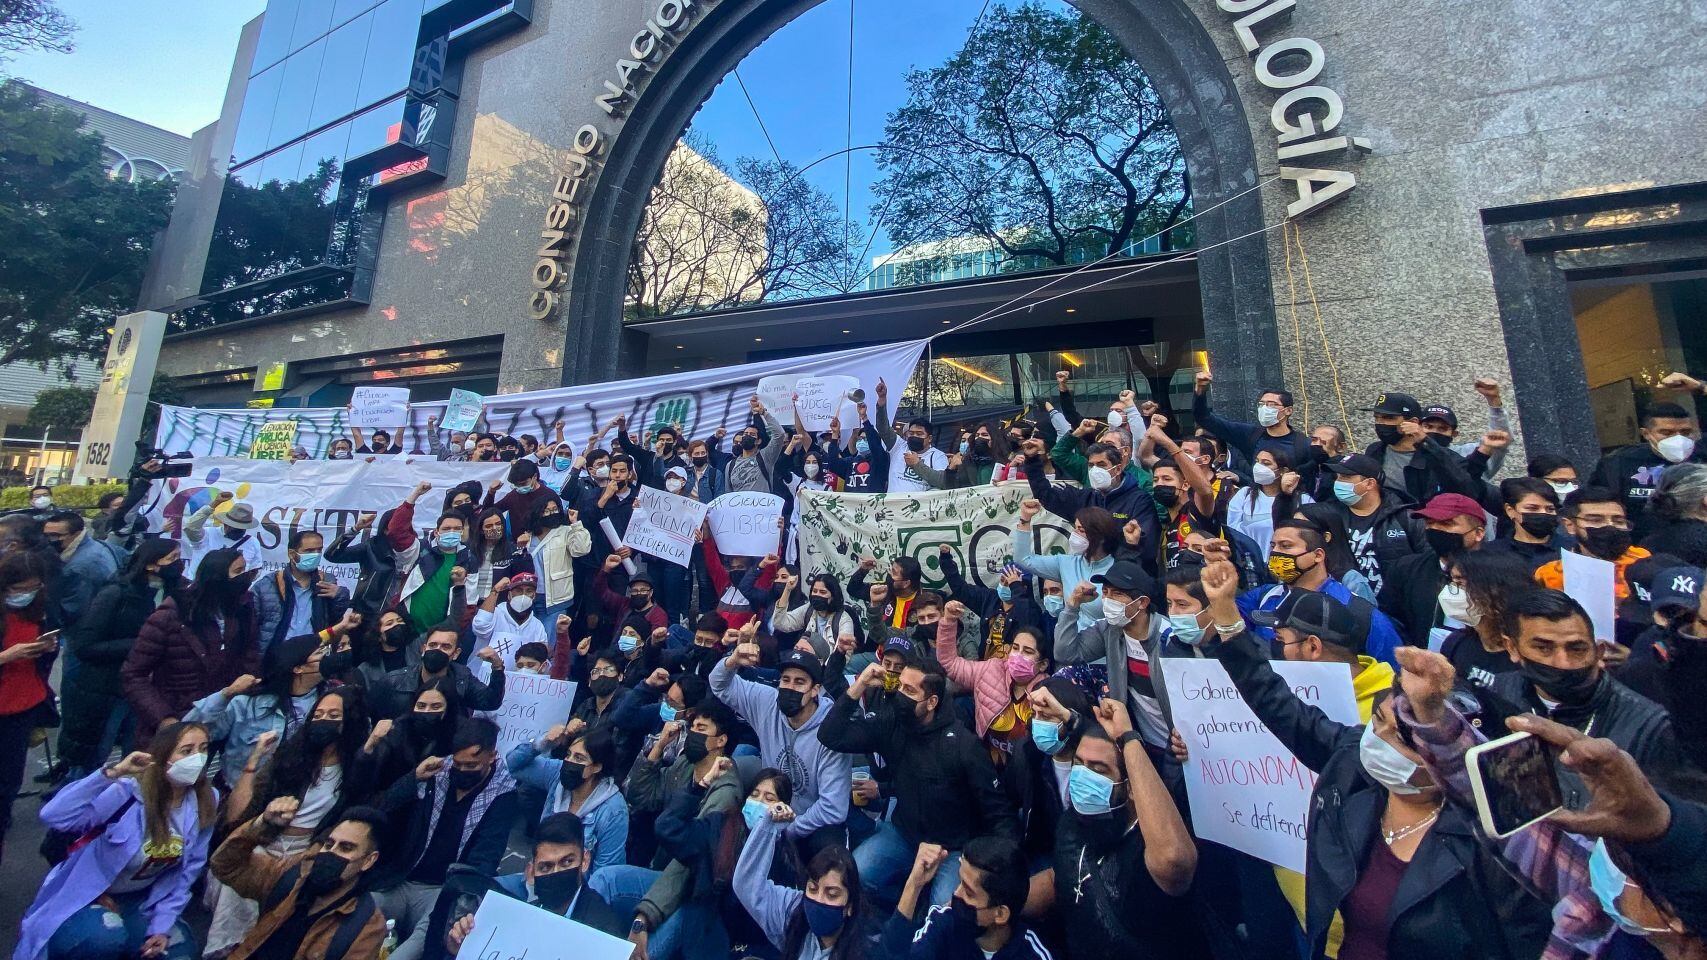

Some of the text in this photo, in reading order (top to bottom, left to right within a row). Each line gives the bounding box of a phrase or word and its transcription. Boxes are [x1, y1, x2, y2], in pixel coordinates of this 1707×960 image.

[1215, 0, 1372, 218] LOGÍA
[528, 0, 696, 320] CONSEJO NACIO
[86, 442, 111, 466] 1582
[846, 473, 871, 488] NY
[716, 513, 779, 535] LIBRE
[1671, 575, 1696, 594] NY
[1251, 801, 1308, 841] defiend
